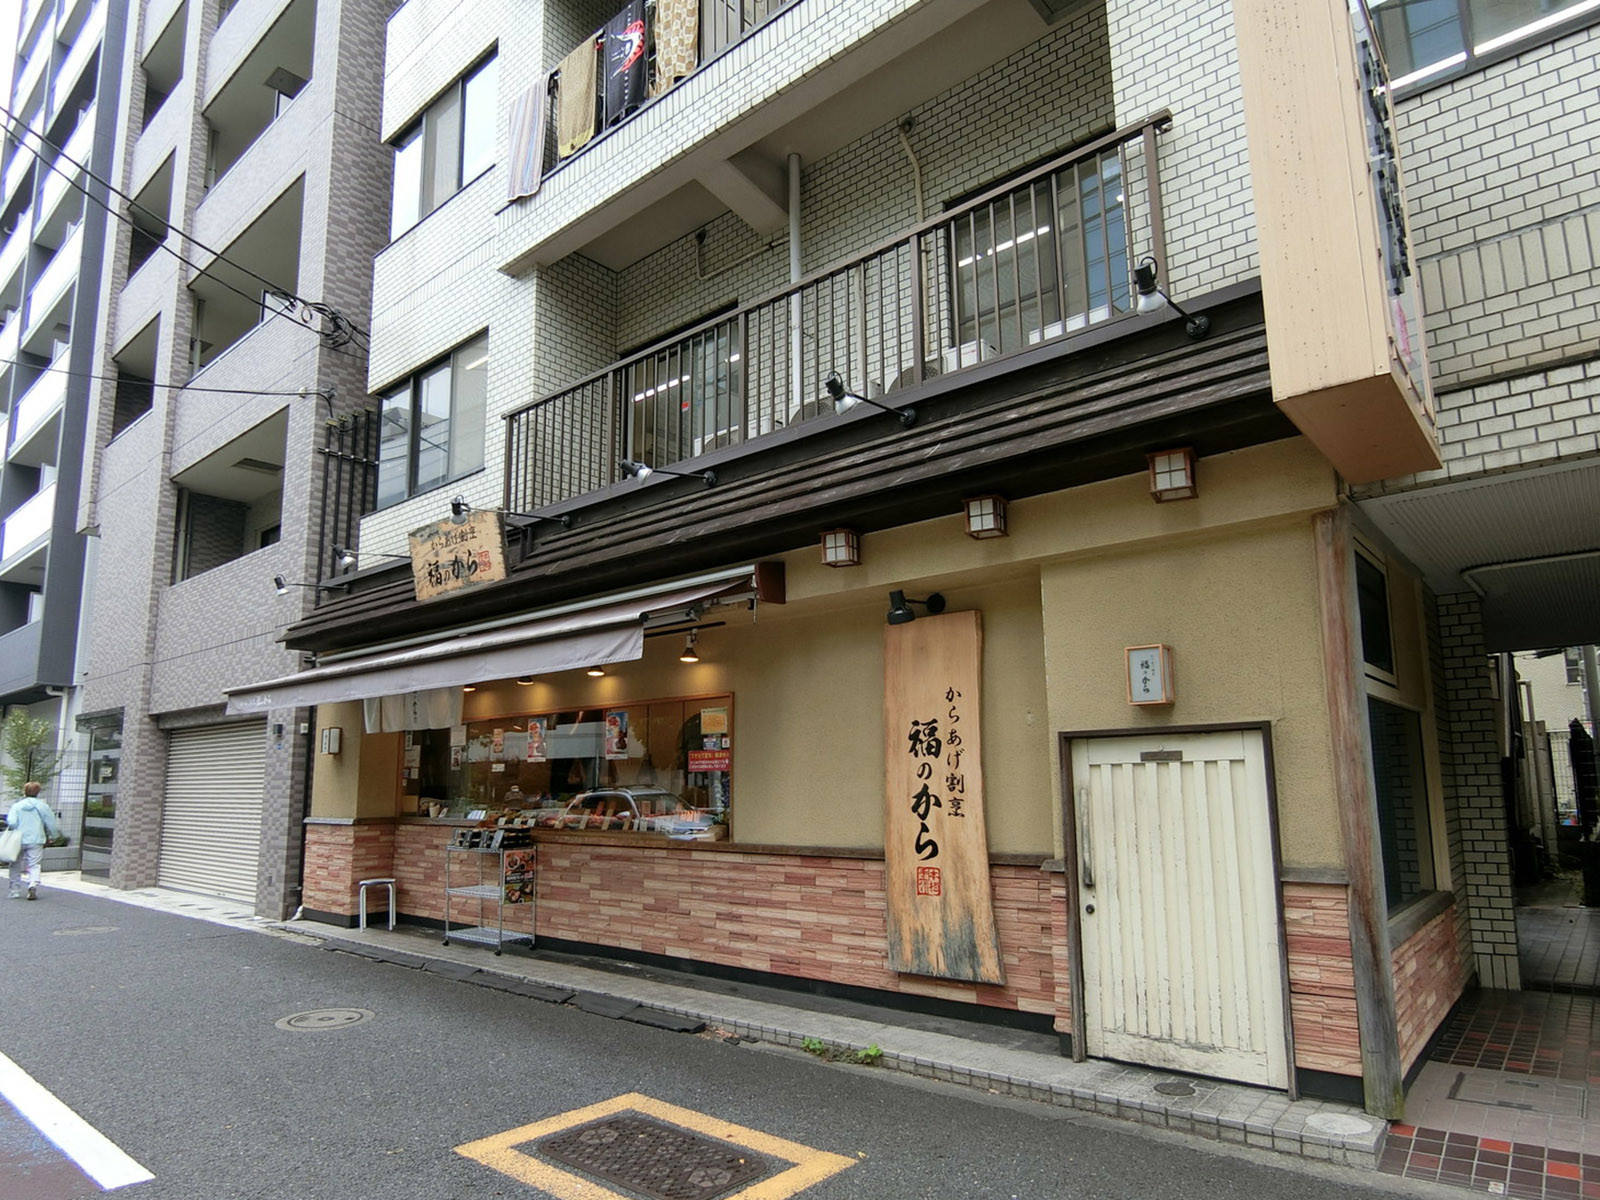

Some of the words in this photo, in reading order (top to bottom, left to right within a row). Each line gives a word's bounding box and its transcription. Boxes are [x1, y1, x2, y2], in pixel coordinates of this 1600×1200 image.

[428, 550, 478, 587] 福のから
[908, 718, 943, 861] 福のから
[945, 686, 966, 818] からあげ割烹
